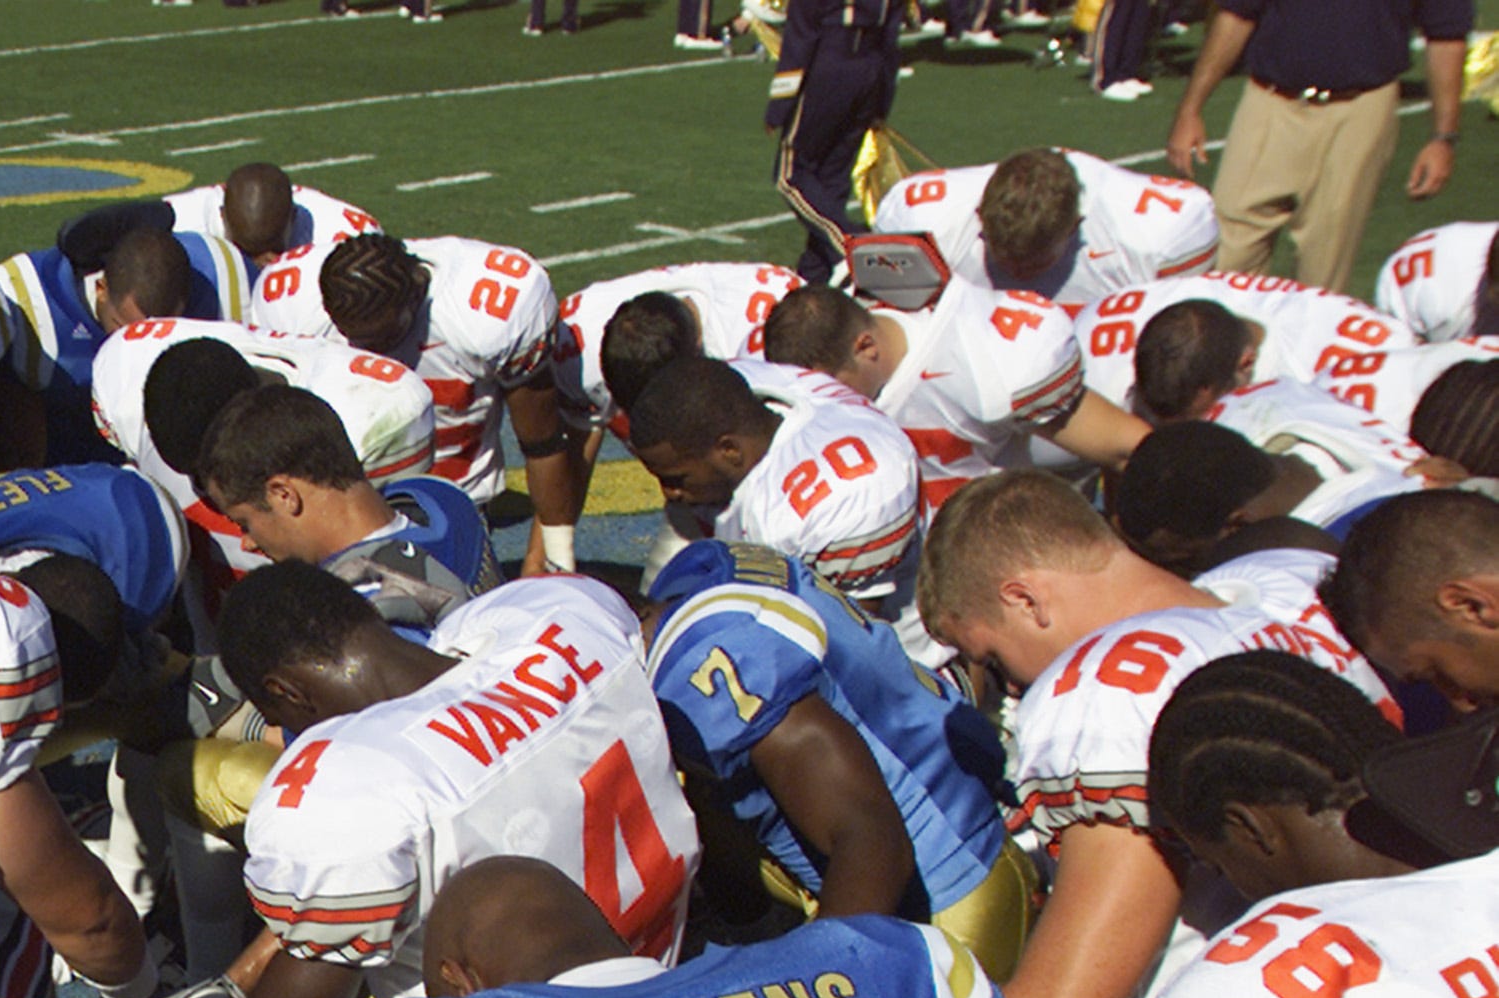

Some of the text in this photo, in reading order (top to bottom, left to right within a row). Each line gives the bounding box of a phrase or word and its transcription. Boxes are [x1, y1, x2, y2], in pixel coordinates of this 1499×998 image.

[467, 248, 551, 322] 26
[1390, 232, 1437, 288] 5
[781, 435, 878, 520] 20
[425, 622, 605, 768] VANCE
[688, 645, 764, 723] 7
[1052, 630, 1185, 698] 16
[270, 738, 332, 809] 4
